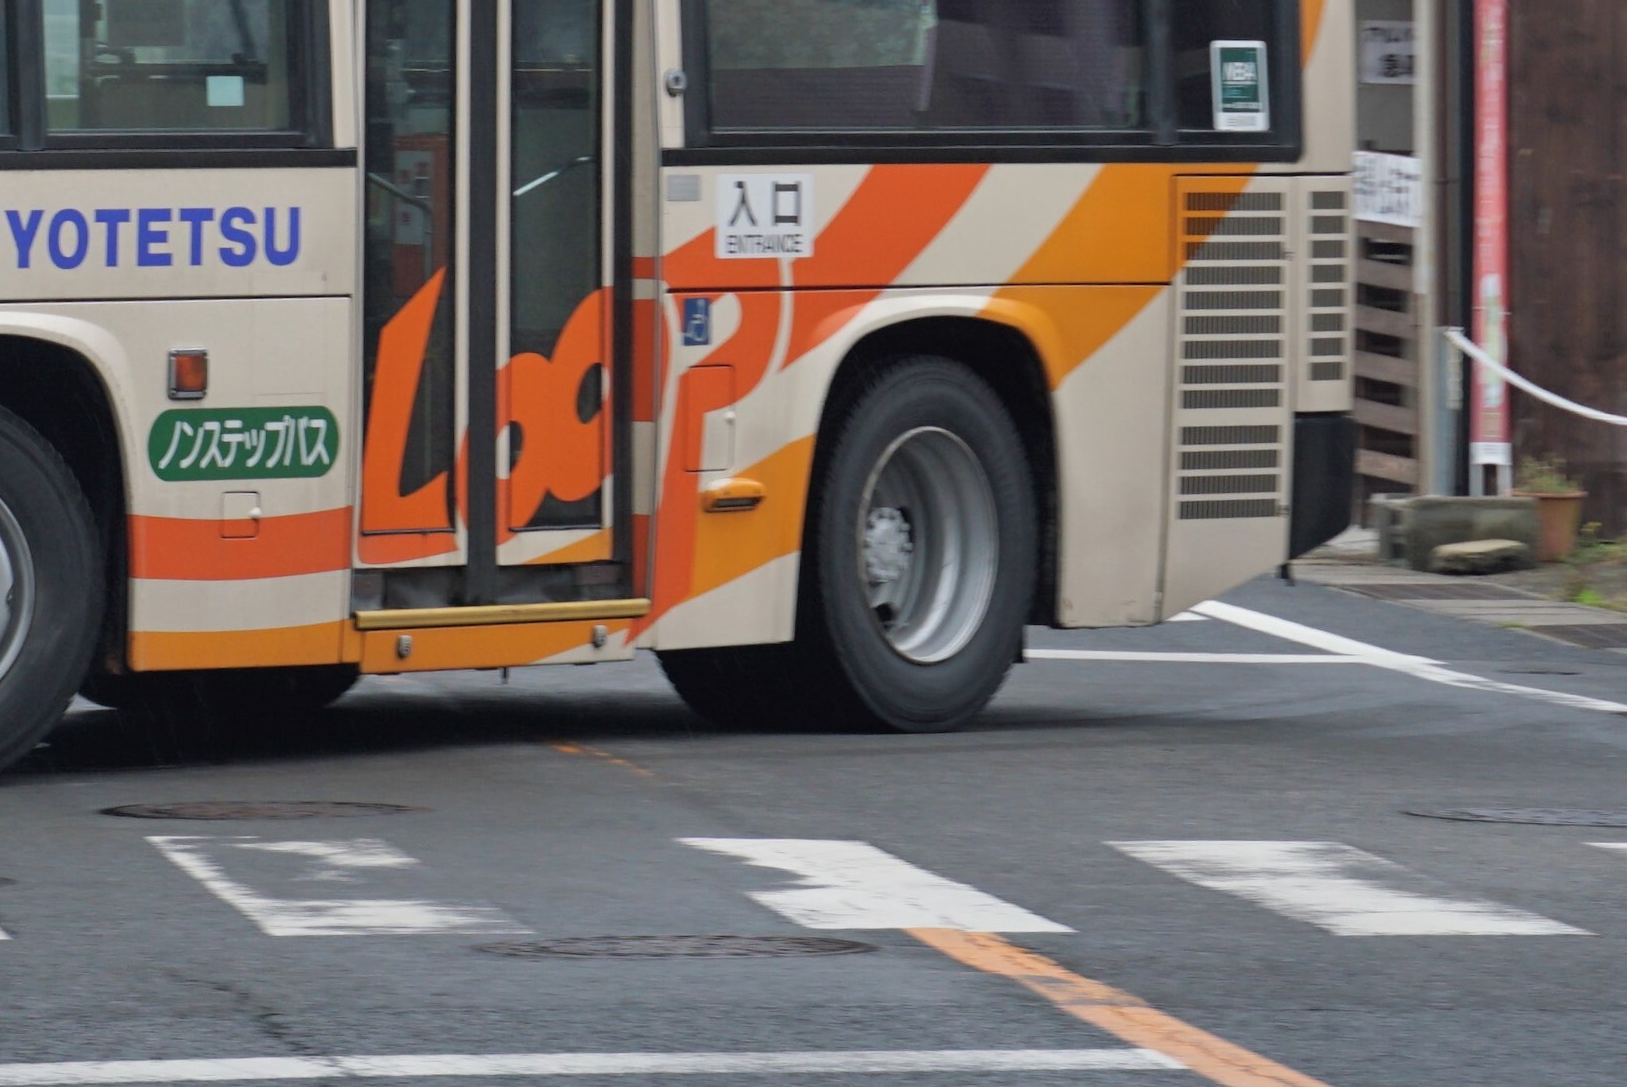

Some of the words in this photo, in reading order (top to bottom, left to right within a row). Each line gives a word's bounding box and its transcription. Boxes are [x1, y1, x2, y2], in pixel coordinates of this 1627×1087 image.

[728, 180, 802, 226] 入口
[726, 233, 804, 254] ENTRANCE
[158, 415, 330, 469] ノンステップバス
